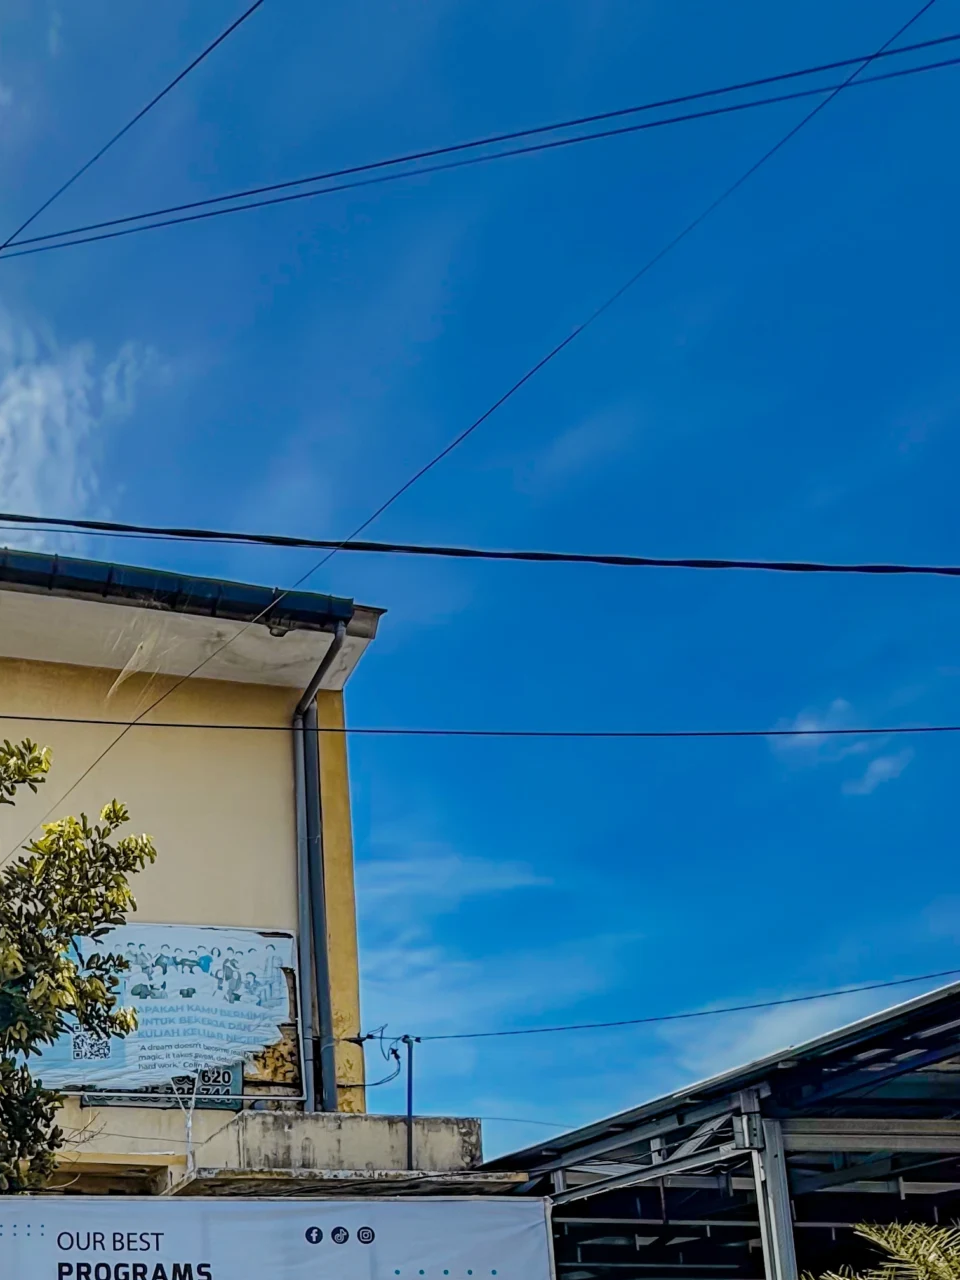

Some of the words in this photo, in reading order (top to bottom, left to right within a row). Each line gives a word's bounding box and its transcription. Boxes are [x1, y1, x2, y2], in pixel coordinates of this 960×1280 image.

[147, 1043, 173, 1051] dream
[57, 1231, 106, 1251] OUR
[112, 1232, 165, 1251] BEST
